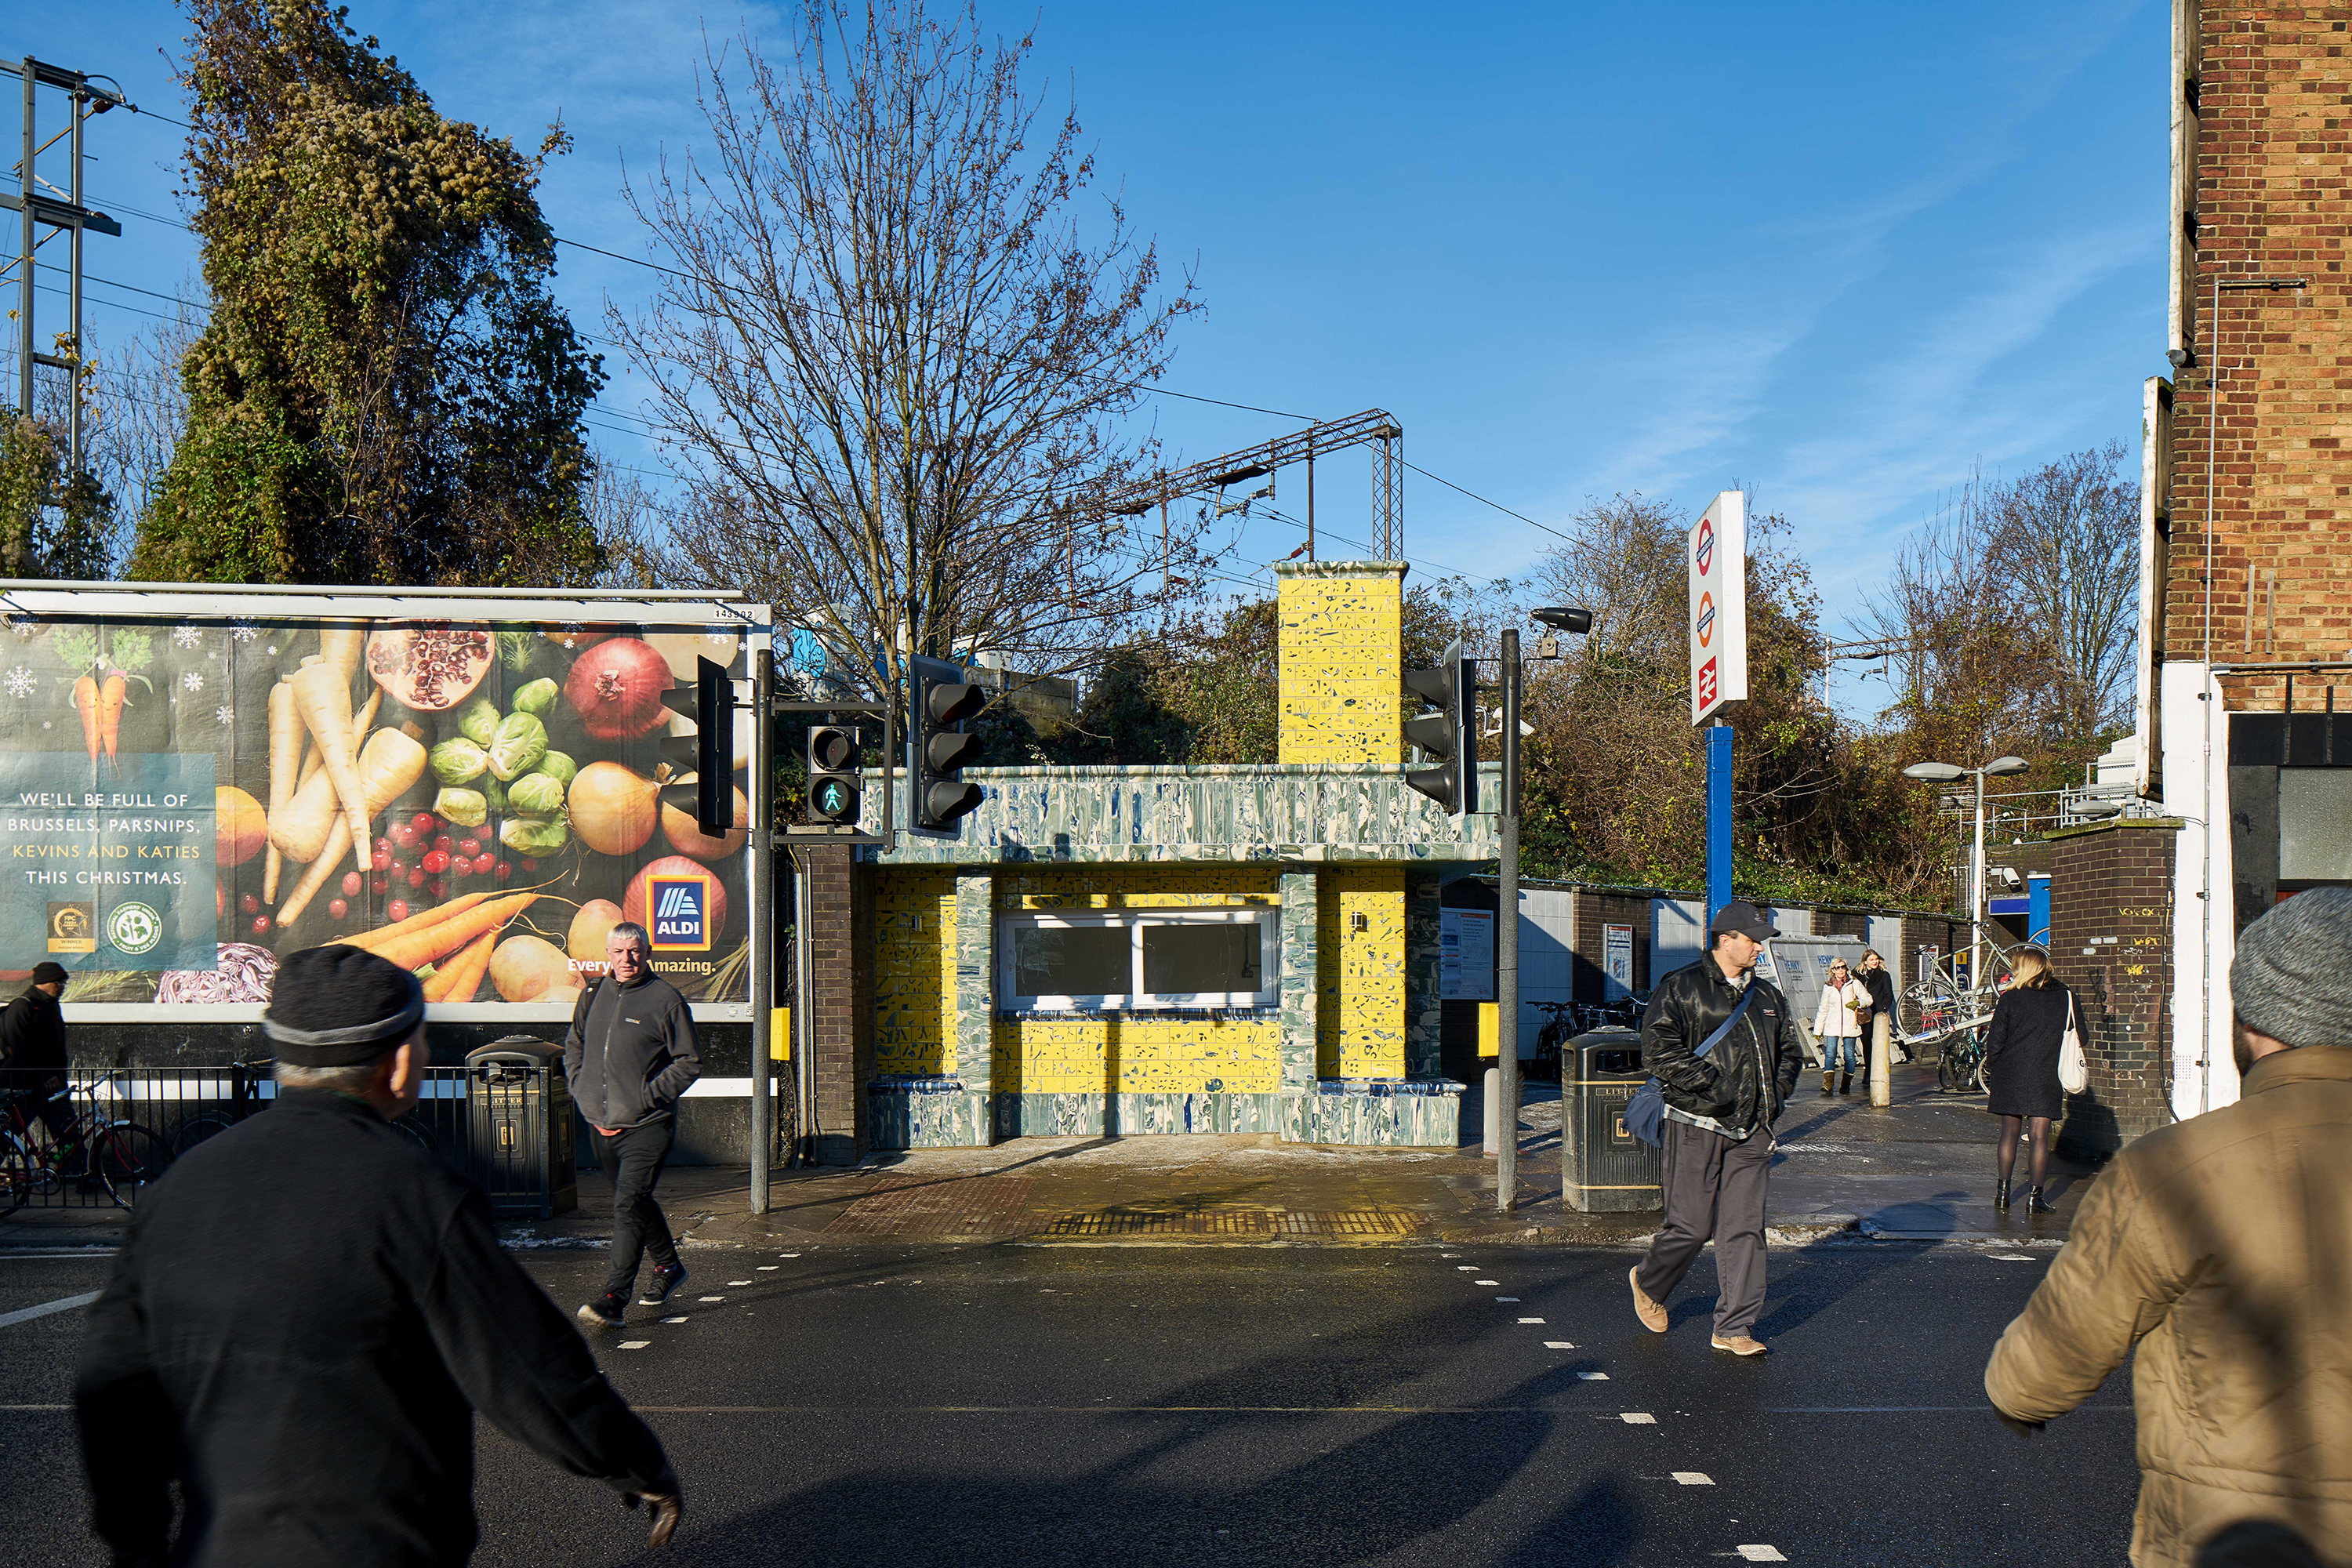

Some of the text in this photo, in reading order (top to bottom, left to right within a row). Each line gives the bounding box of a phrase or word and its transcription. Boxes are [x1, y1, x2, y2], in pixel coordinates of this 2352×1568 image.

[716, 609, 753, 619] 143902
[20, 793, 188, 808] WE'LL BE FULL OF
[8, 818, 201, 834] BRUSSELS, PARSNIPS,
[13, 844, 200, 858] KEVINS AND KATIES
[25, 871, 187, 884] THIS CHRISTMAS.
[657, 921, 699, 935] ALDI
[568, 958, 614, 975] Every
